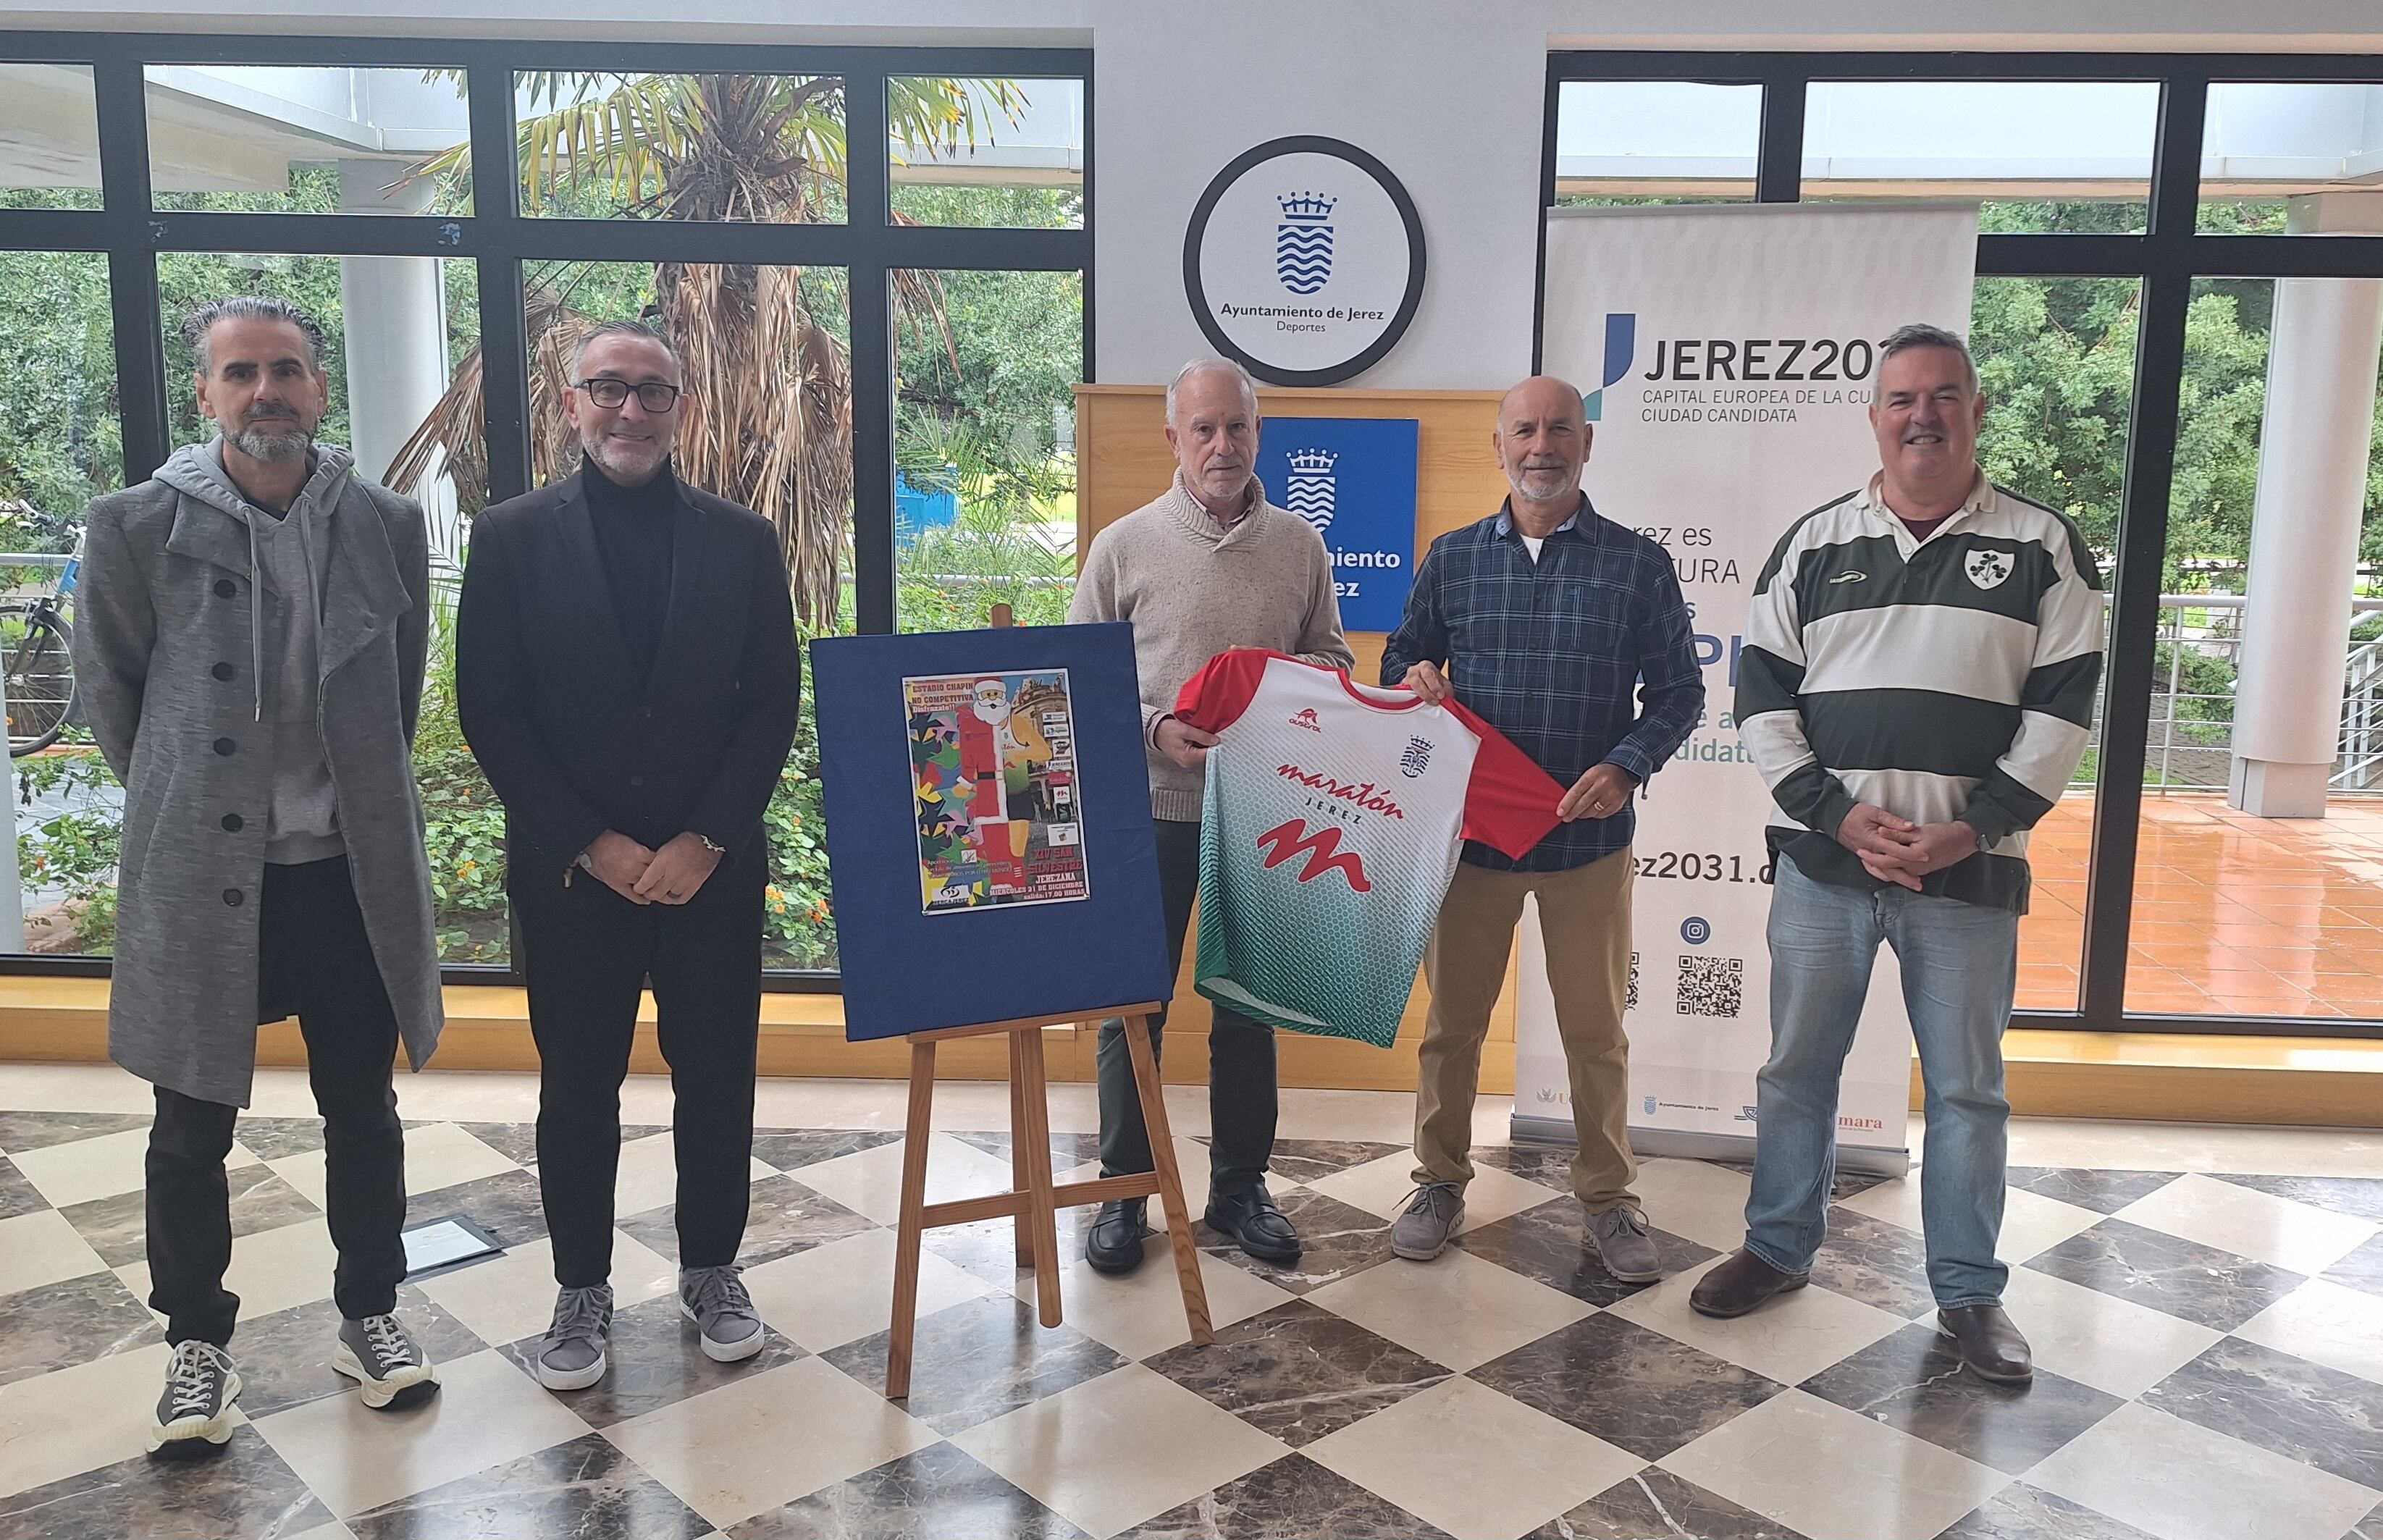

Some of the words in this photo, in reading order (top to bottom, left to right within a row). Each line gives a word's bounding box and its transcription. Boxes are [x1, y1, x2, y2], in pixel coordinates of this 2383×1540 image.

[1220, 303, 1323, 320] Ayuntamiento
[1326, 307, 1344, 319] de
[1347, 308, 1384, 321] Jerez
[1277, 321, 1326, 334] Deportes
[1644, 339, 1890, 382] JEREZ20
[1642, 390, 1707, 404] CAPITAL
[1712, 390, 1790, 404] EUROPEA
[1796, 390, 1817, 404] DE
[1822, 390, 1843, 404] LA
[1641, 408, 1702, 423] CIUDAD
[1707, 408, 1798, 424] CANDIDATA
[1682, 527, 1713, 547] es
[1671, 557, 1741, 584] URA
[912, 684, 944, 693] ESTADIO
[924, 694, 974, 704] COMPETITIVA
[1277, 764, 1404, 820] maratón
[1305, 797, 1362, 825] JEREZ
[1035, 872, 1076, 883] JEREZANA
[1048, 881, 1083, 891] DICIEMBRE
